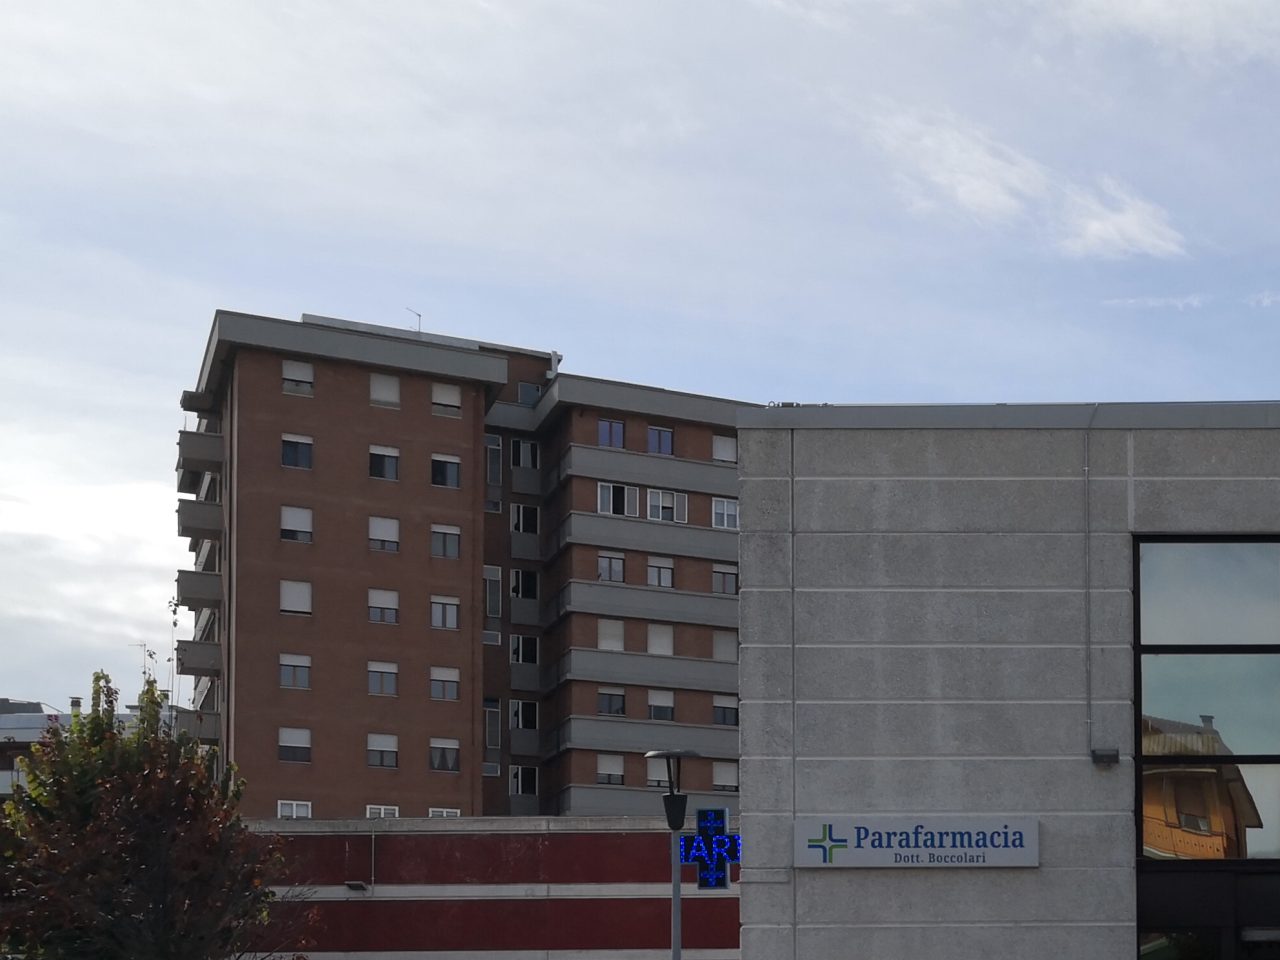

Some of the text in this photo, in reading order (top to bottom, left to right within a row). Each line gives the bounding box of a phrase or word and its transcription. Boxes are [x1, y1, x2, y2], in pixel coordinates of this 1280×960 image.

[854, 824, 1025, 849] Parafarmacia
[893, 851, 986, 864] Dott. Boccolari
